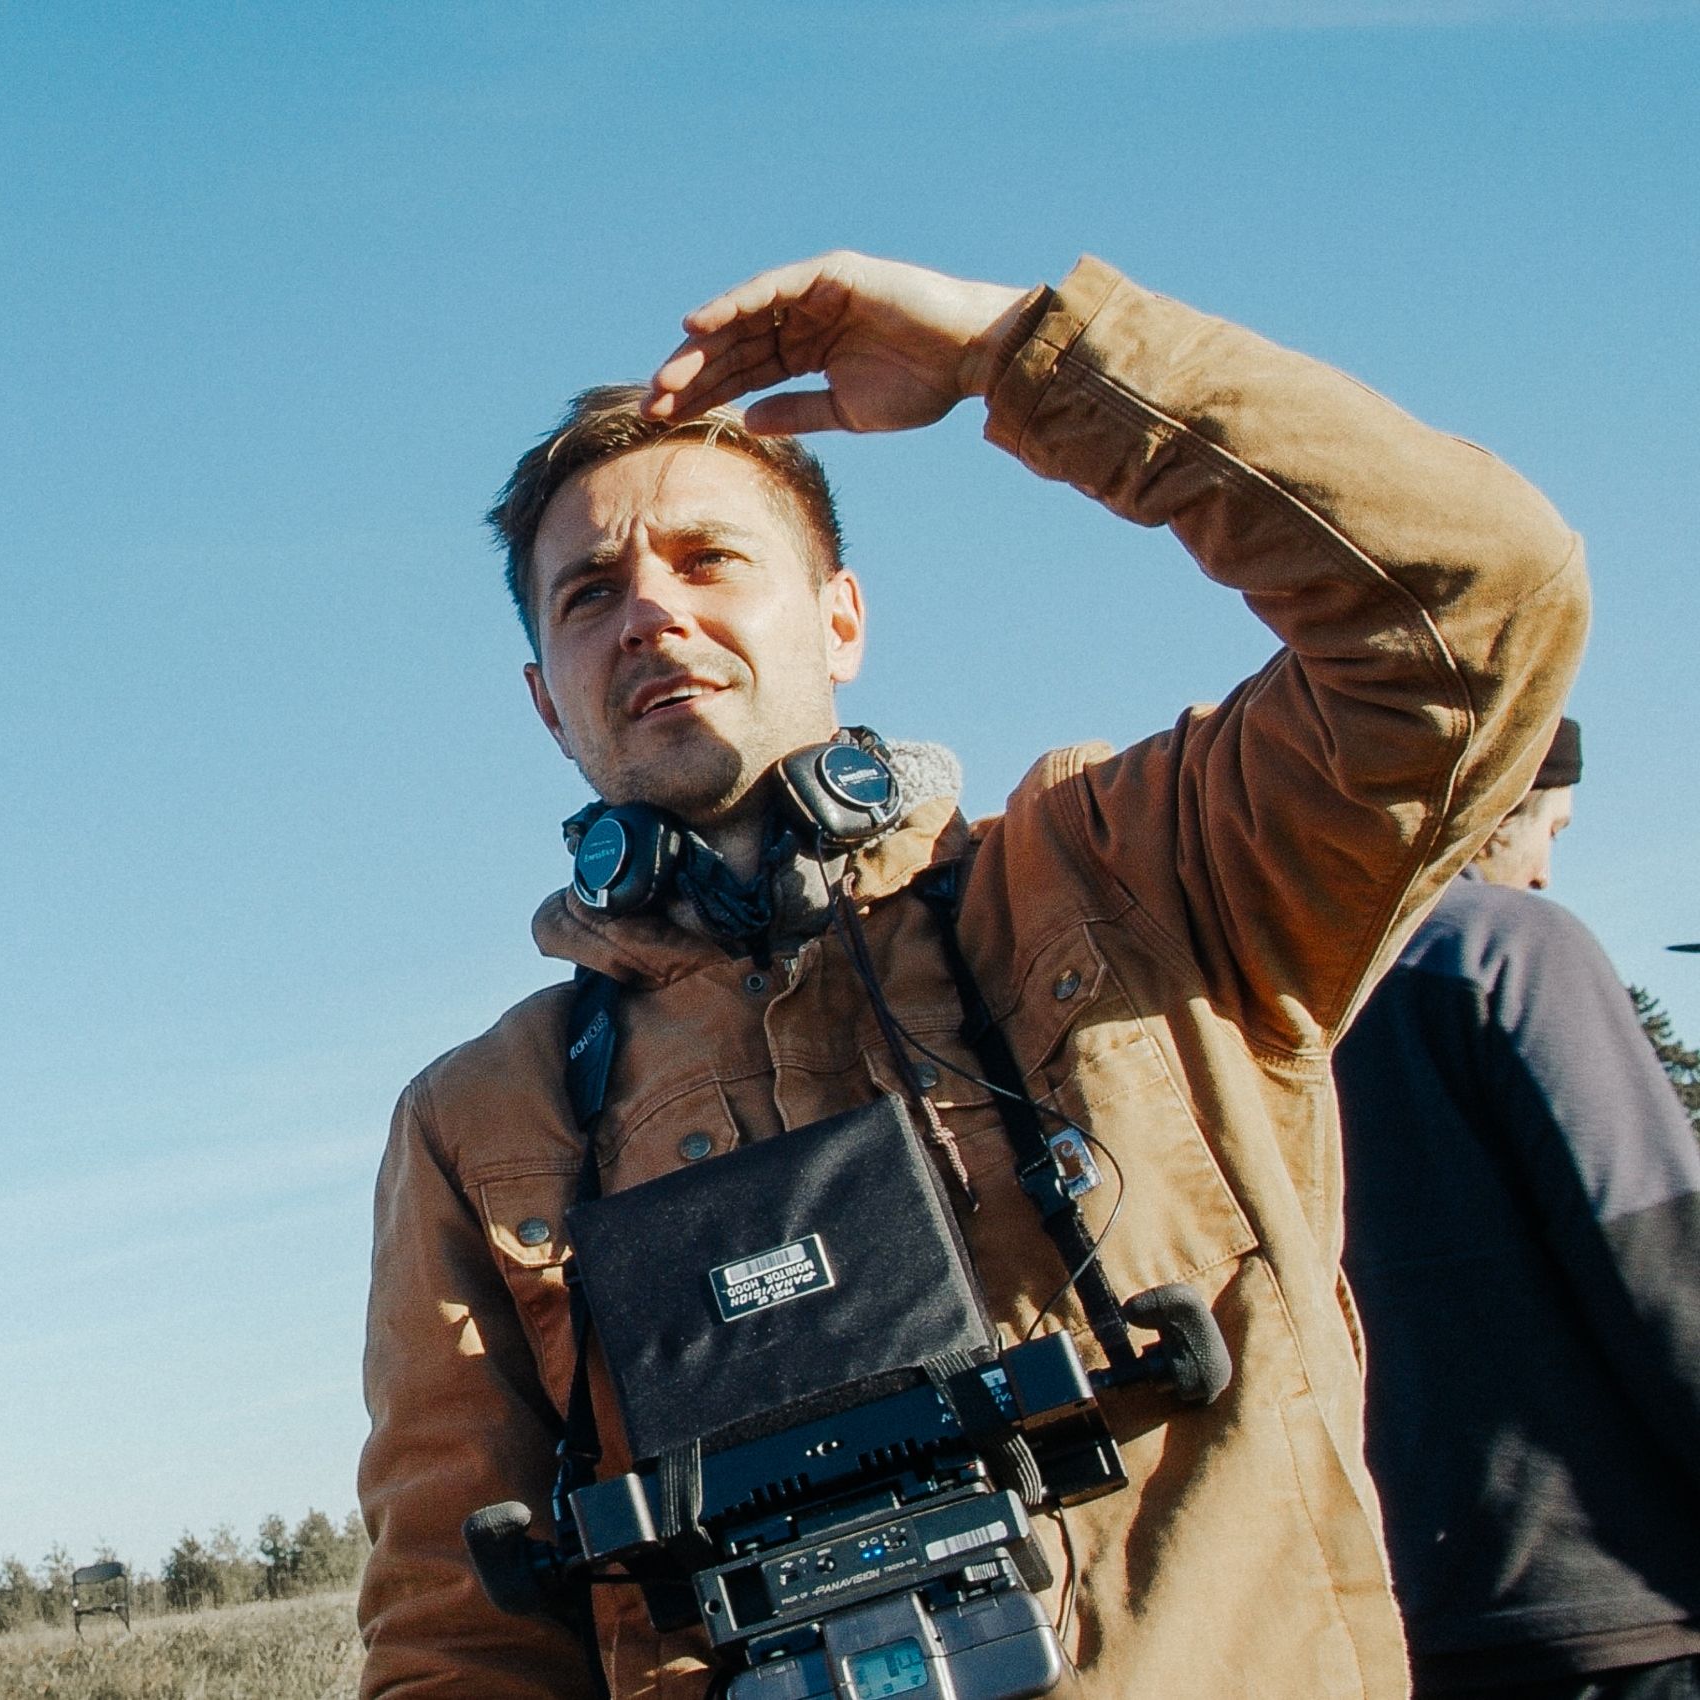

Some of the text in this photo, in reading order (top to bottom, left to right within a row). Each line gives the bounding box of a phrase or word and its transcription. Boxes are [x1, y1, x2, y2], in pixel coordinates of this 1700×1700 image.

[726, 1259, 815, 1298] MONITOR HOOD
[730, 1271, 817, 1307] PANAVISION
[812, 1568, 880, 1596] PANAVISION
